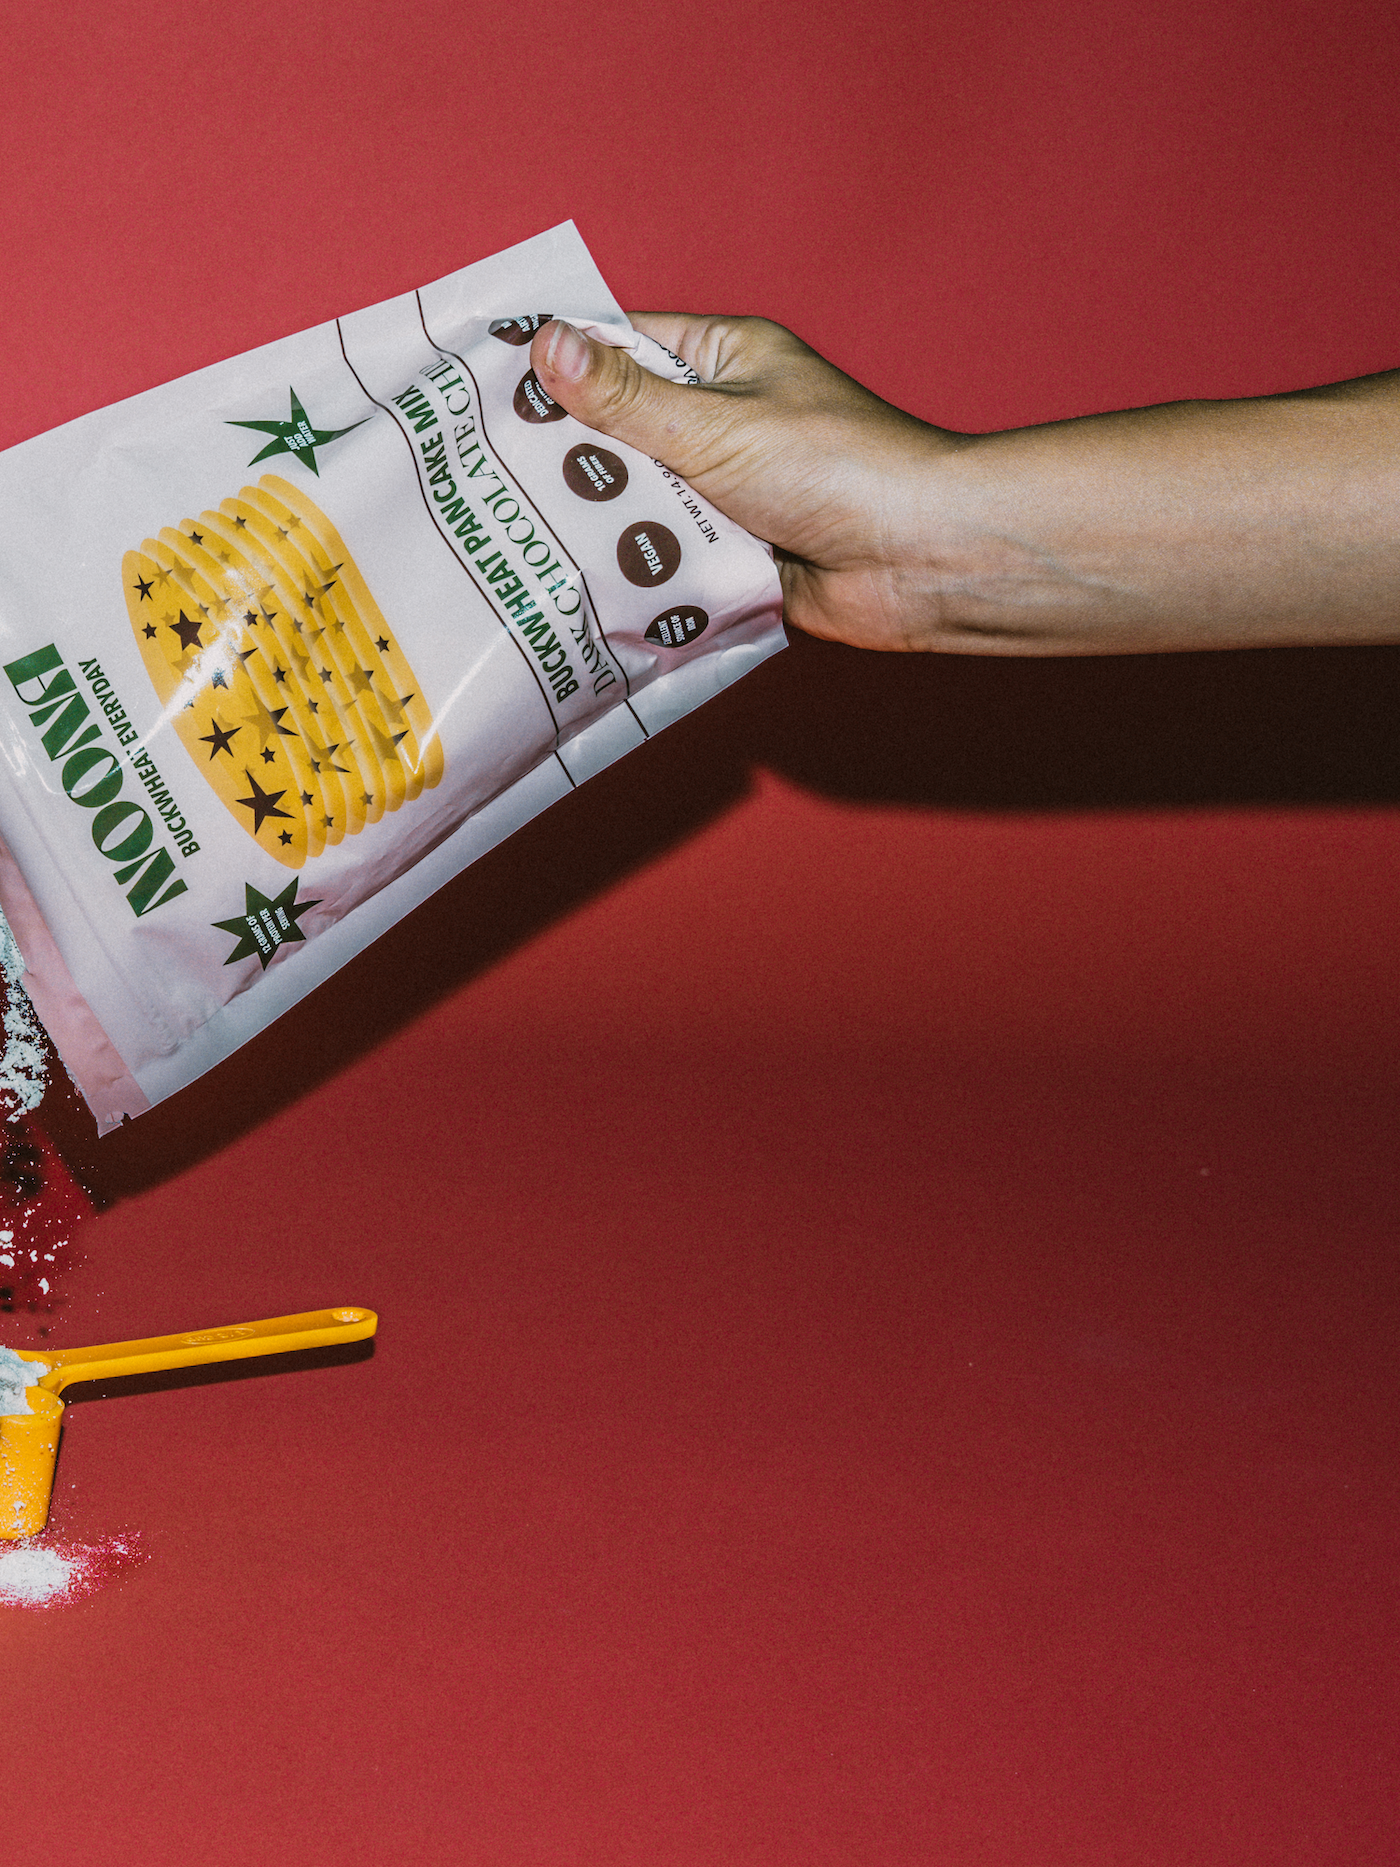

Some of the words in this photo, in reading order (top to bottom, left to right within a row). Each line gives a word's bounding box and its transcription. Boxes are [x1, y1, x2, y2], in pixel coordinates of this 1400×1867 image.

[391, 384, 438, 434] MIX
[523, 379, 549, 418] DEDICATED
[283, 436, 301, 451] JUST
[293, 433, 309, 447] ADD
[297, 420, 317, 444] WATER
[576, 455, 599, 481] GRAMS
[589, 454, 608, 475] FIBER
[594, 480, 606, 491] 10
[602, 474, 615, 484] OF
[420, 431, 492, 555] PANCAKE
[454, 415, 581, 615] CHOCOLATE
[682, 495, 702, 519] WT.
[696, 519, 719, 543] NET
[634, 532, 664, 576] VEGAN
[475, 551, 580, 703] BUCKWHEAT
[657, 620, 673, 645] EXCELLENT
[569, 610, 616, 697] DARK
[78, 657, 138, 747] EVERYDAY
[3, 643, 189, 918] NOONA
[129, 746, 201, 858] BUCKWHEAT
[245, 915, 257, 926] OF
[259, 907, 272, 922] PER
[251, 924, 268, 946] GRAMS
[265, 919, 283, 945] PROTEIN
[262, 943, 272, 954] 12
